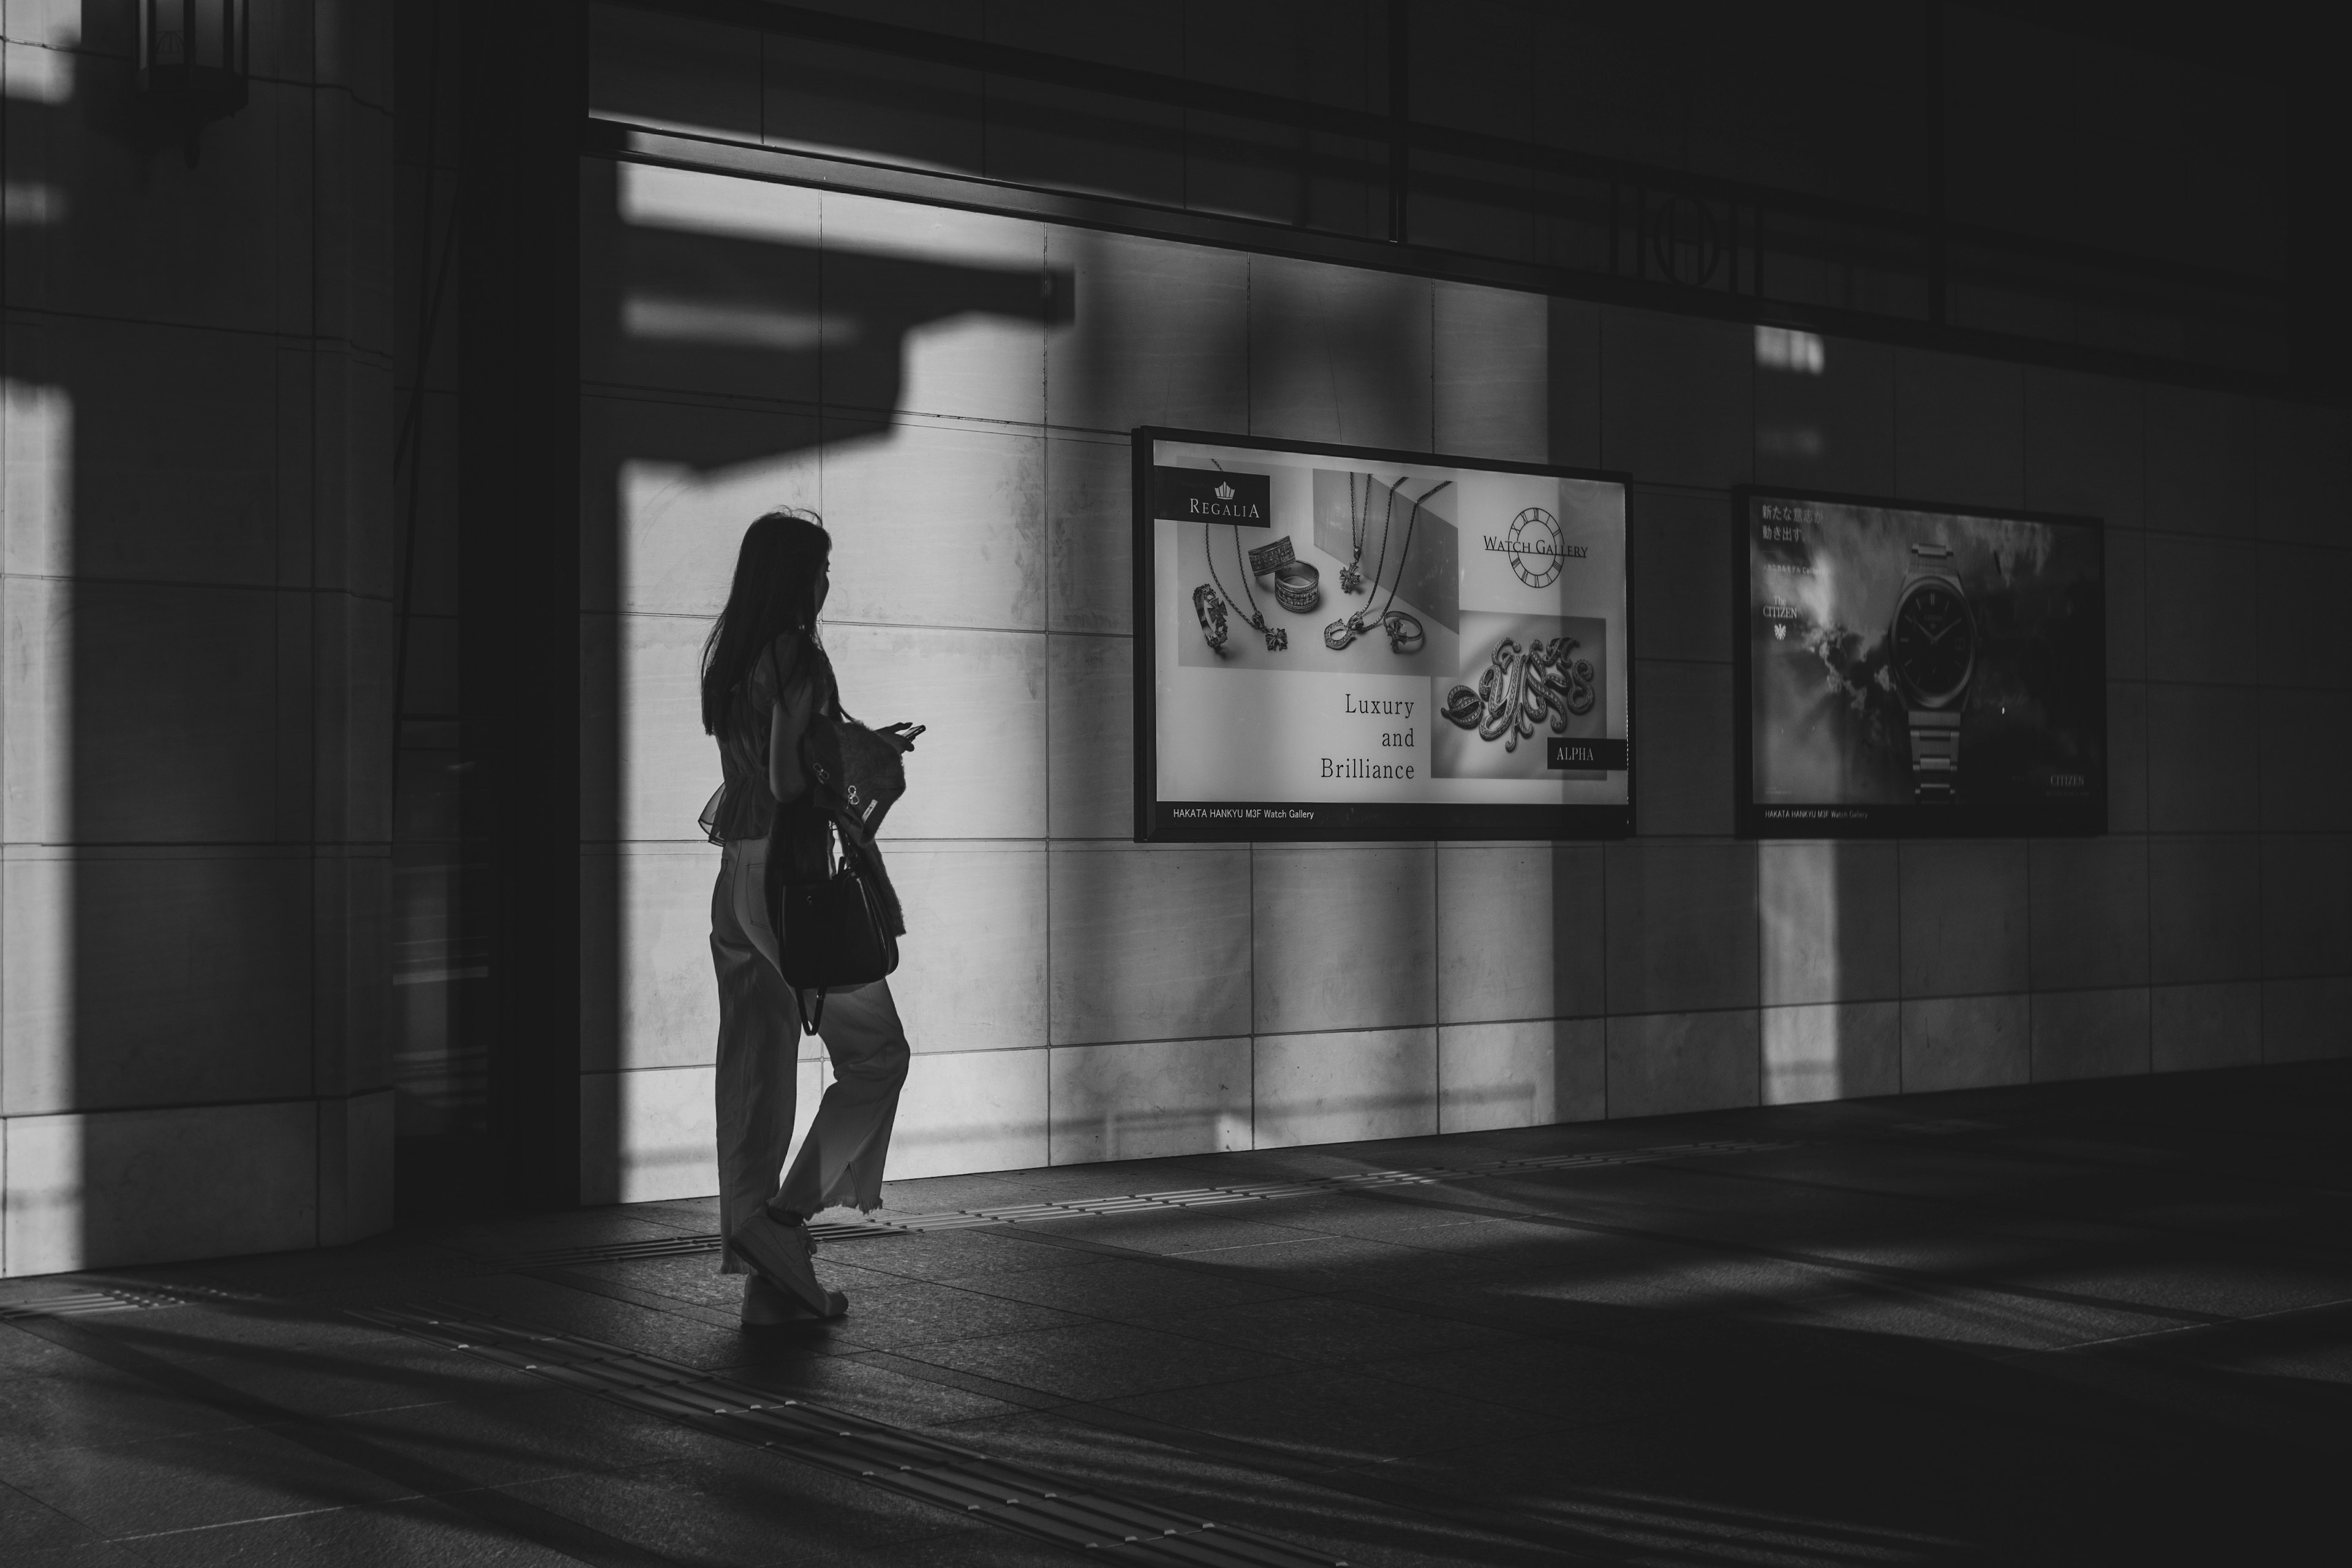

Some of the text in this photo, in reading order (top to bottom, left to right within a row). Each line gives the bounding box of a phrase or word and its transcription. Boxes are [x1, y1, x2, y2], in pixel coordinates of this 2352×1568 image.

[1190, 498, 1259, 518] REGALIA
[1763, 606, 1797, 619] CITIZEN
[1345, 693, 1414, 718] Luxury
[1382, 728, 1414, 747] and
[1556, 747, 1594, 760] ALPHA
[1321, 758, 1414, 779] Brilliance
[2051, 774, 2084, 786] CITIZEN
[1174, 809, 1207, 817] HAKATA
[1210, 809, 1243, 818] HANKYU
[1246, 809, 1261, 818] M3F
[1289, 809, 1314, 820] Gallery
[1849, 810, 1868, 820] Gallery
